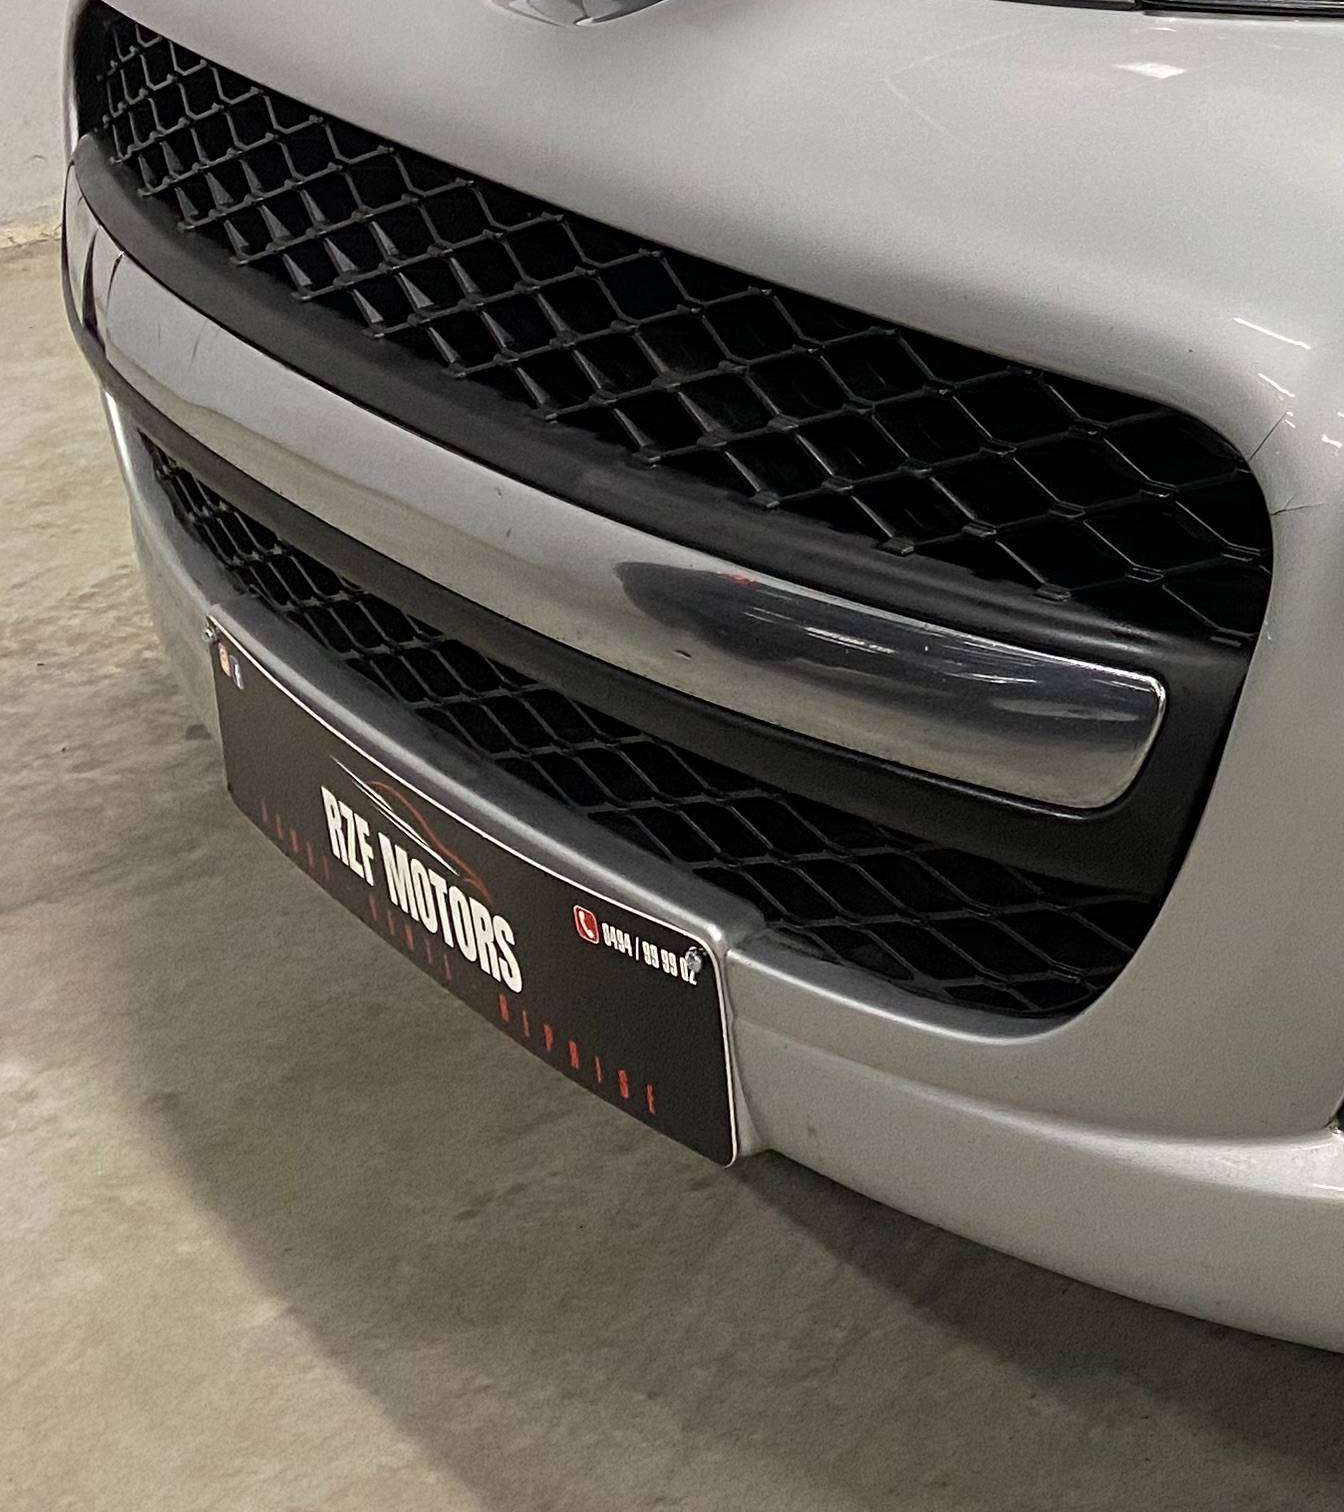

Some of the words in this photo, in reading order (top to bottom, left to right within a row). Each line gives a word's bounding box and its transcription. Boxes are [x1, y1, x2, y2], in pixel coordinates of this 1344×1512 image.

[320, 785, 375, 887] RZF
[377, 831, 523, 993] MOTORS
[601, 922, 633, 958] 0494
[641, 940, 660, 969] 99
[660, 948, 678, 978] 99
